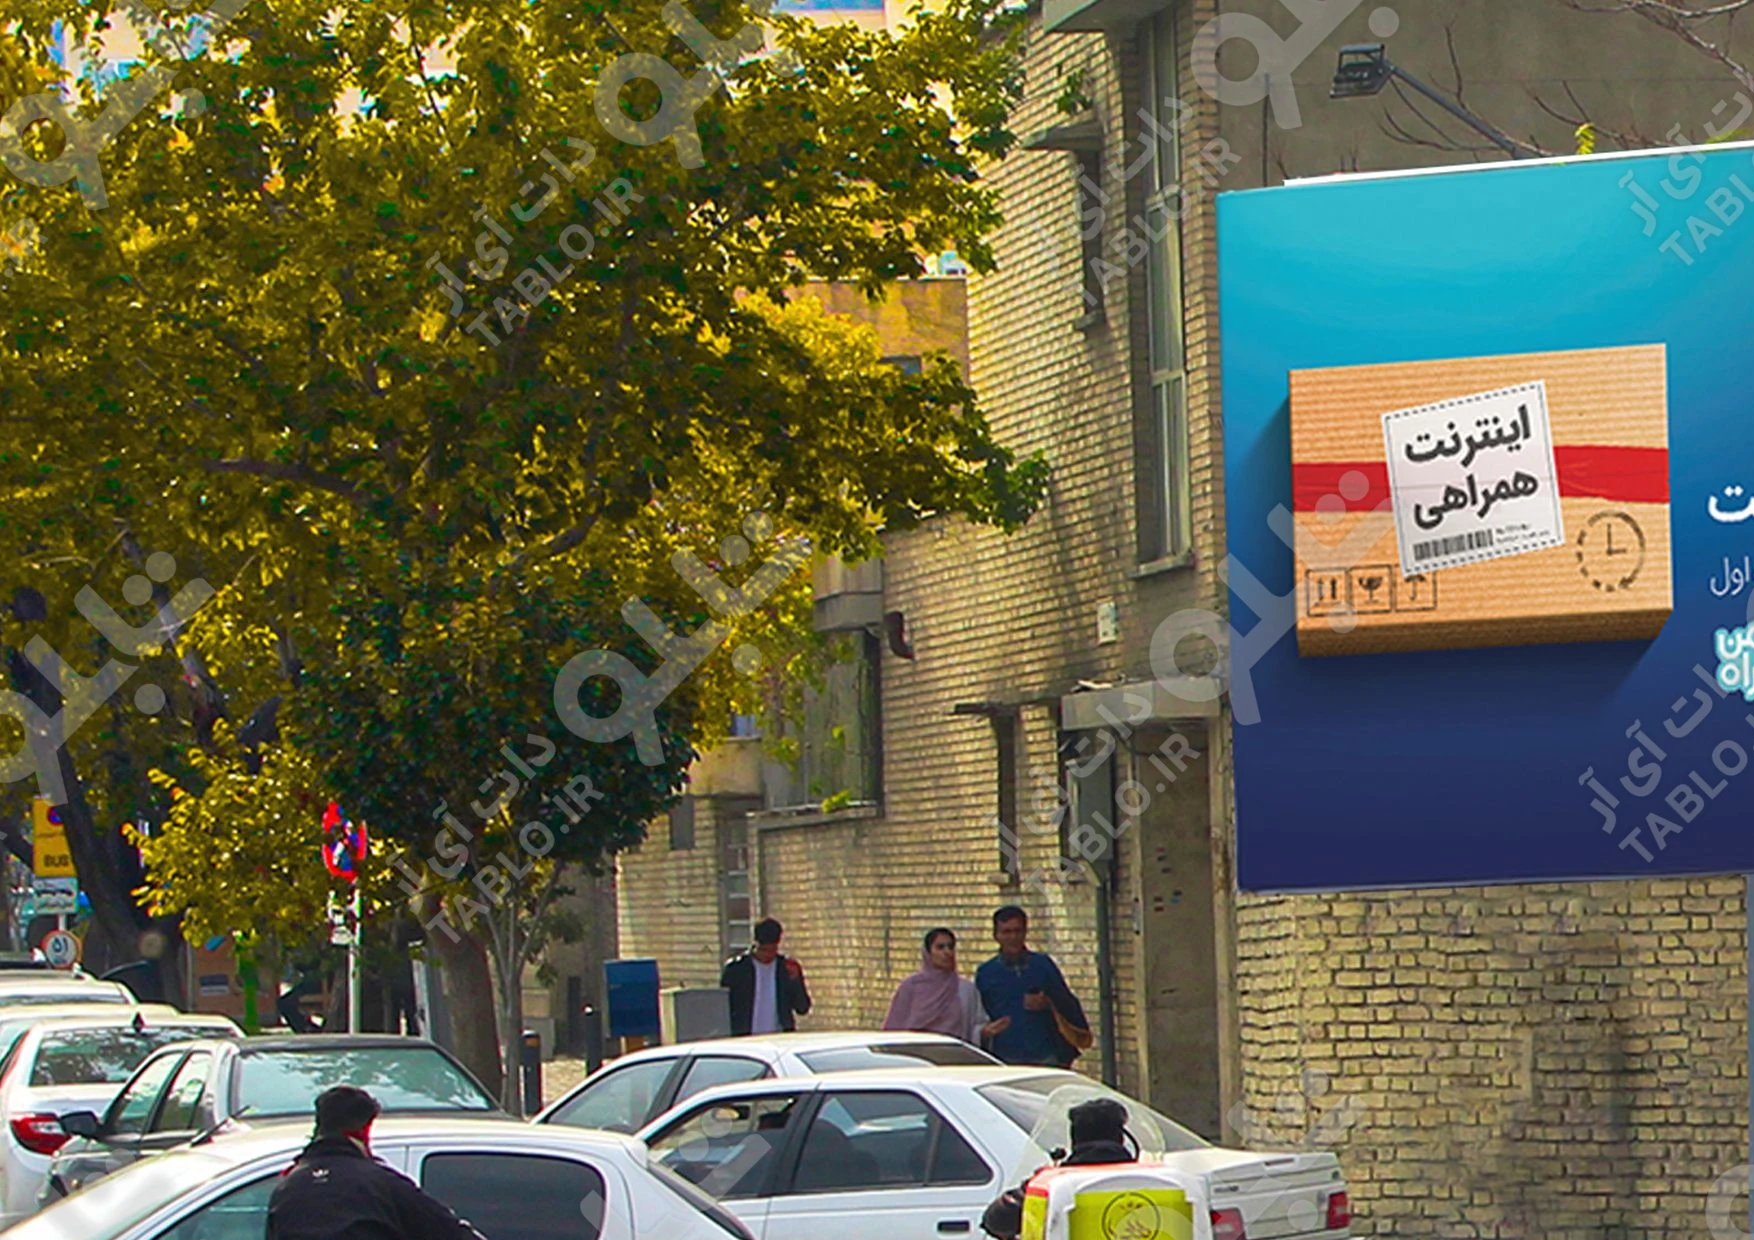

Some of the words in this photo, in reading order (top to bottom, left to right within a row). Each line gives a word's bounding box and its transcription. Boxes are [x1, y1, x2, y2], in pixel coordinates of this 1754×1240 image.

[1405, 404, 1532, 467] اینترنت
[1413, 469, 1539, 529] همراهی
[1709, 557, 1751, 597] اول
